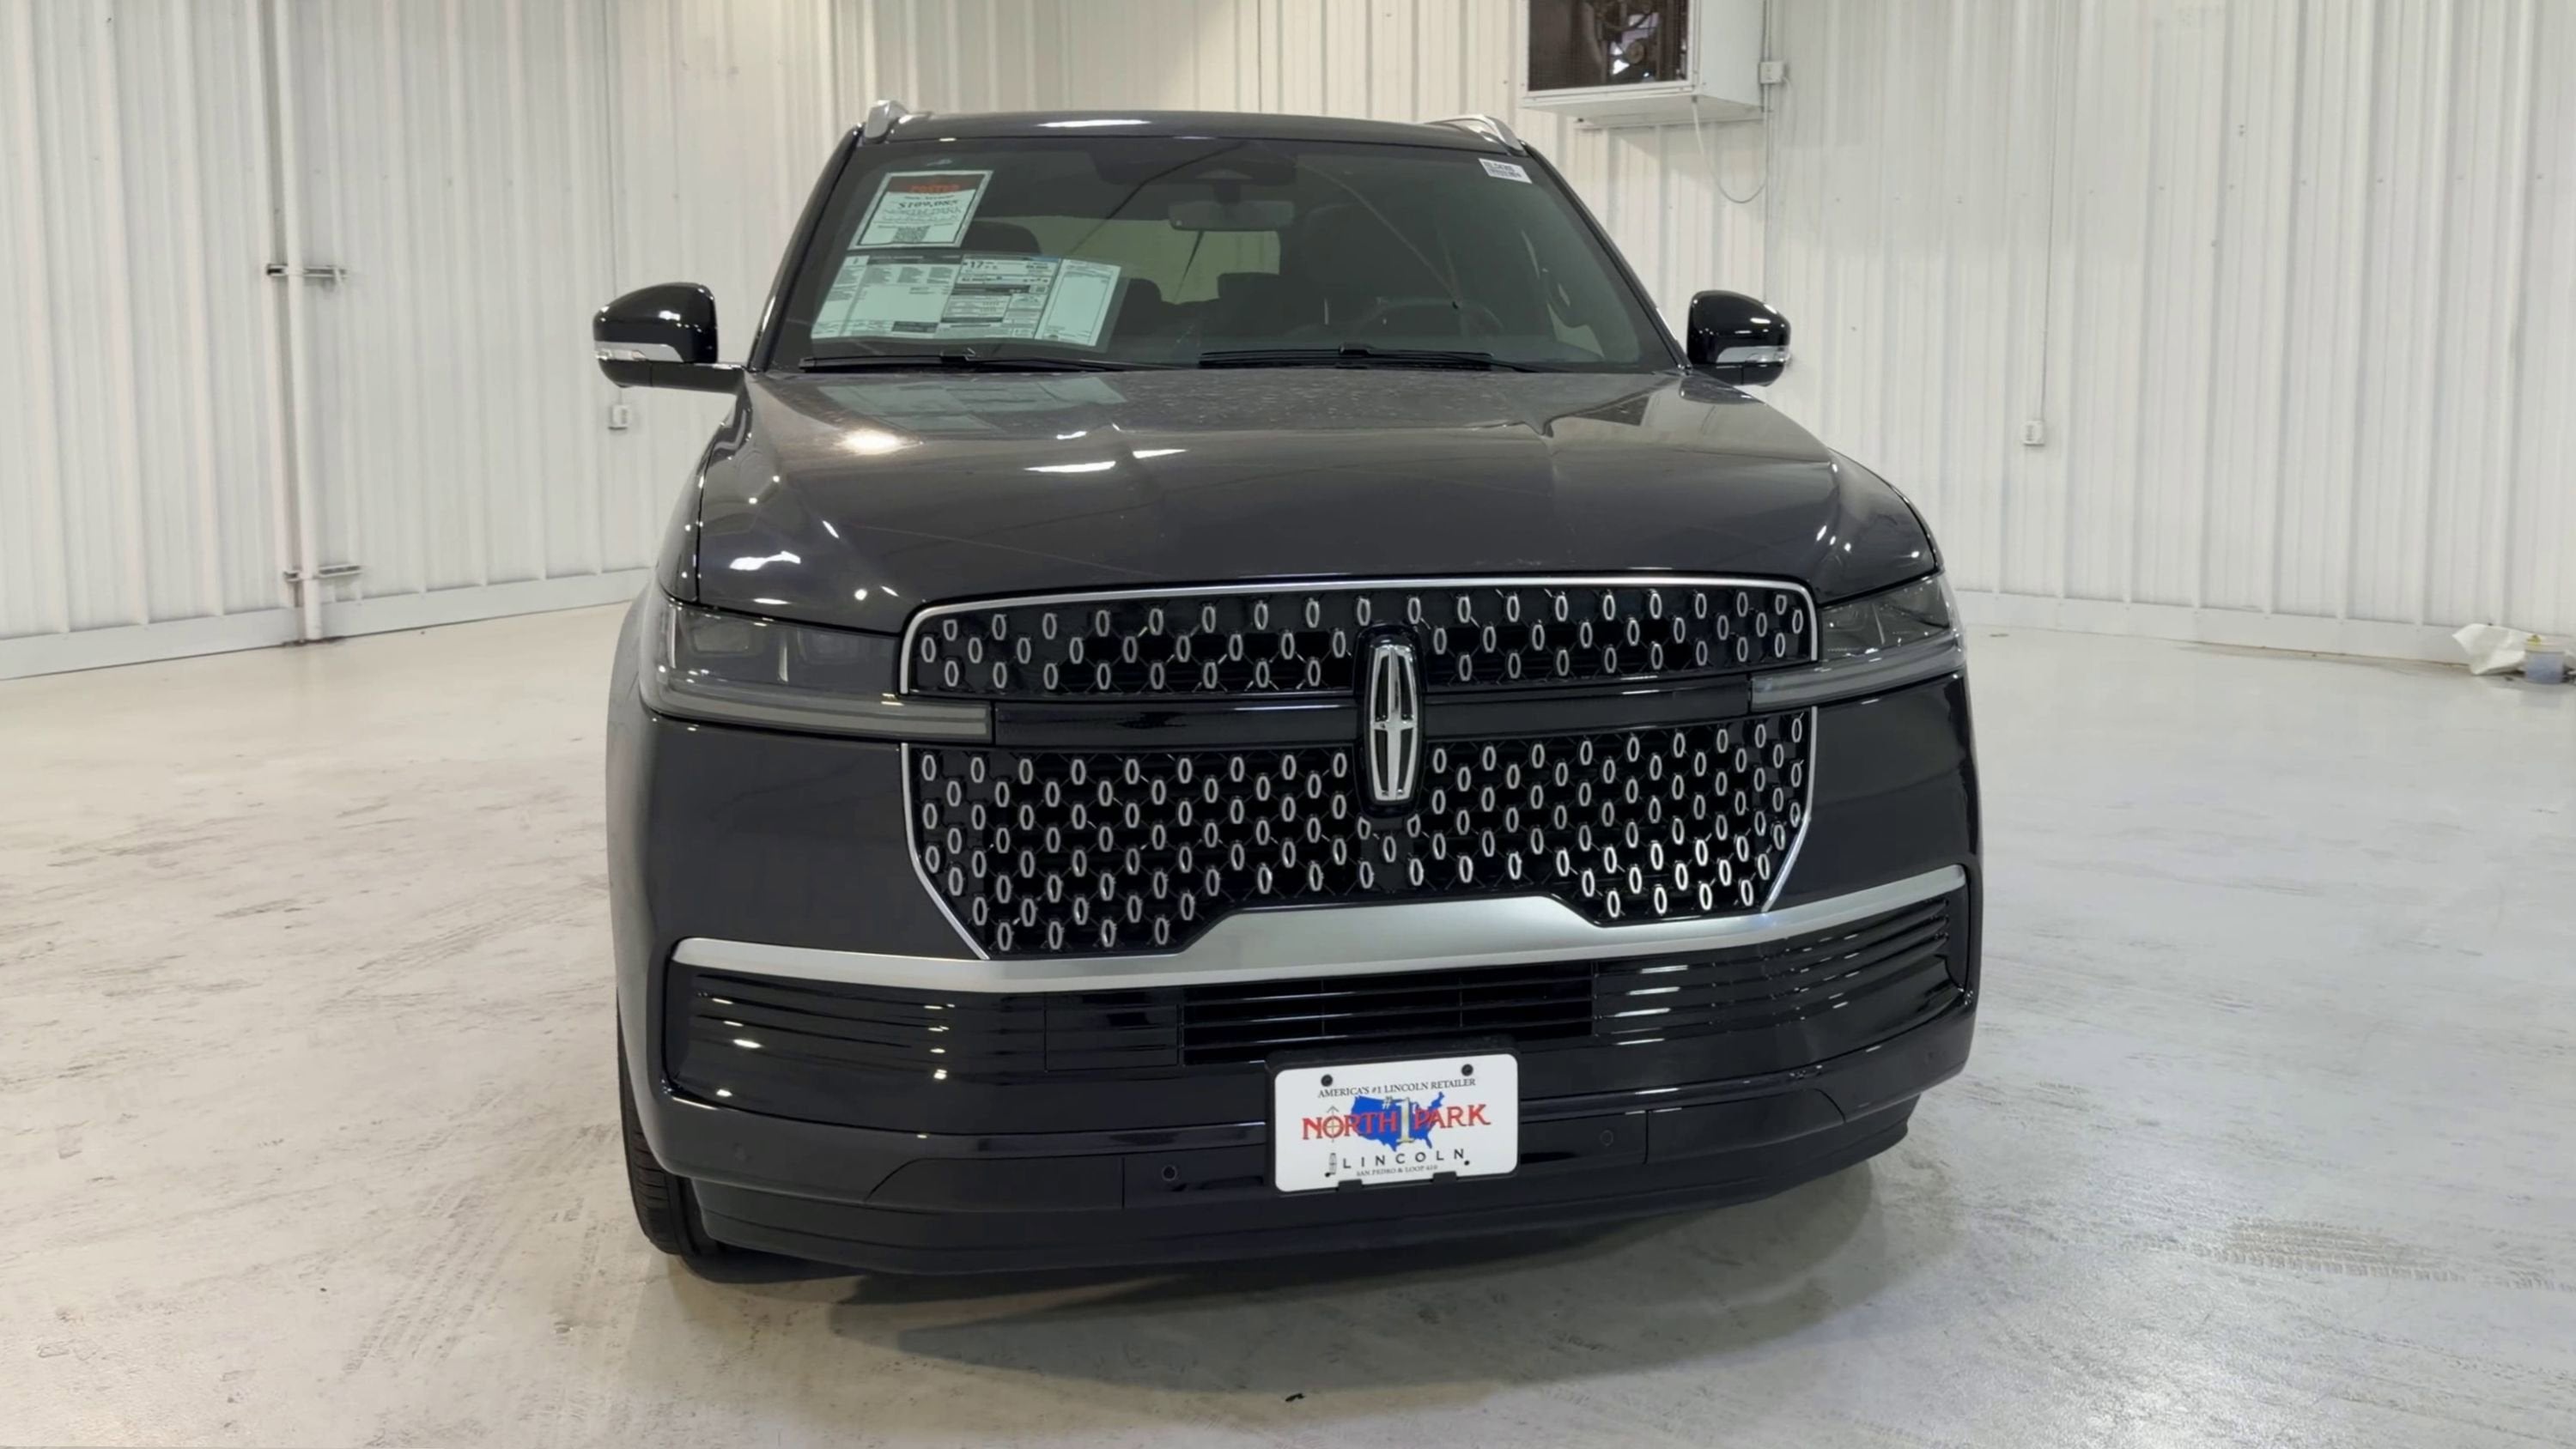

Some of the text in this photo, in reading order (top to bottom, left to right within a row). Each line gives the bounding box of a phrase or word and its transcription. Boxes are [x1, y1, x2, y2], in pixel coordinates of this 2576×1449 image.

[1317, 1086, 1370, 1098] AMERICA'S
[1384, 1082, 1429, 1094] LINCOLN
[1431, 1078, 1476, 1089] RETAILER
[1302, 1104, 1492, 1140] NORTH PARK
[1342, 1149, 1464, 1169] LINCOLN
